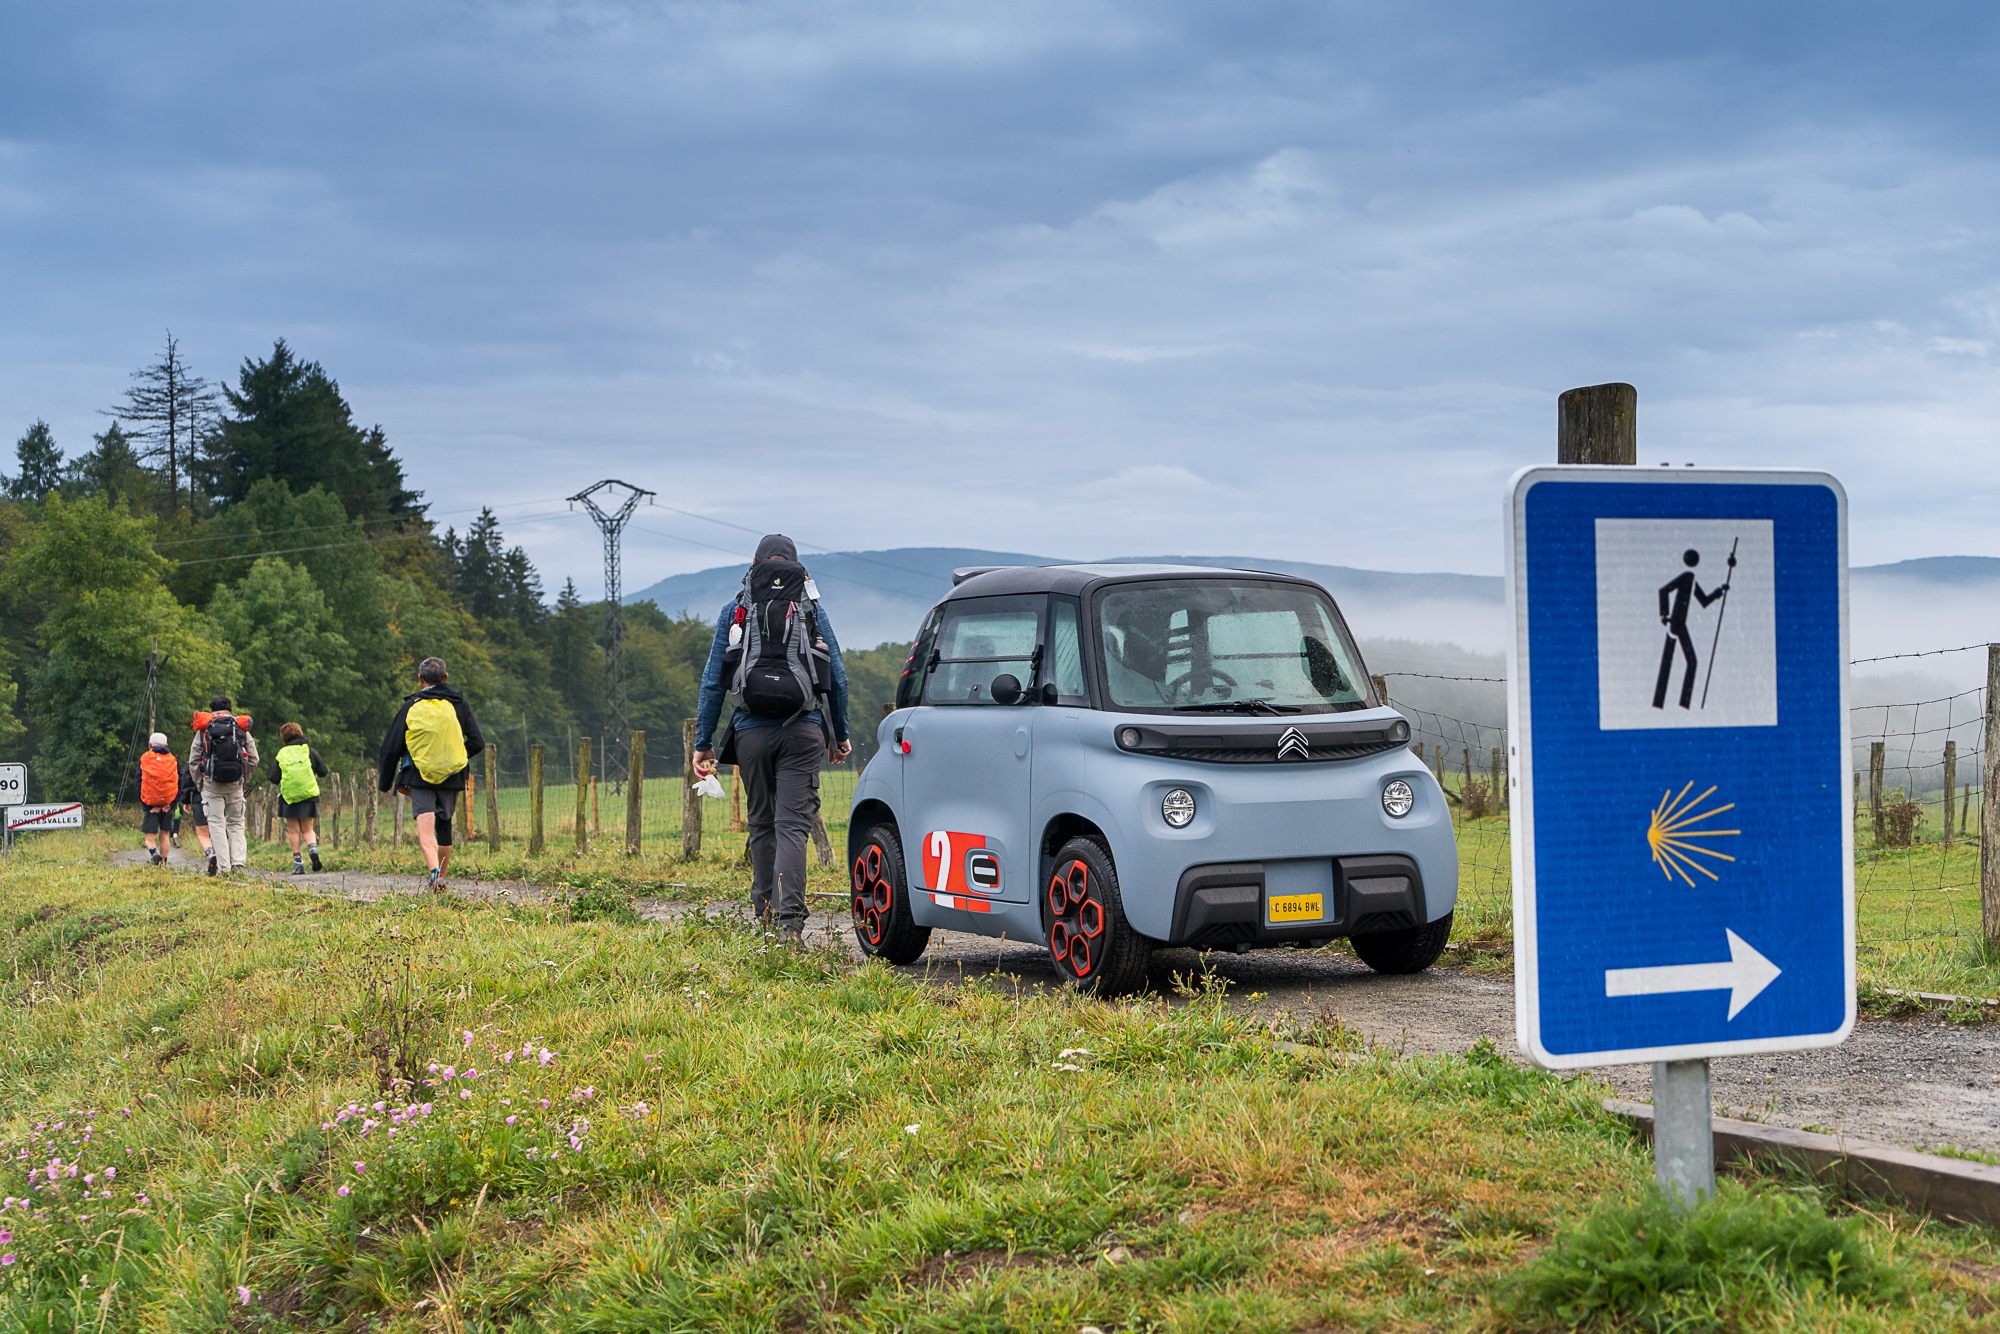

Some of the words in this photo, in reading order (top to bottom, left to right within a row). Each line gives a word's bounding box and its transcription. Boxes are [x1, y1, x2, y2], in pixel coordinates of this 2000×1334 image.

[12, 816, 78, 826] RONCESVALLES
[930, 830, 955, 909] 2
[1275, 902, 1280, 912] C
[1282, 902, 1302, 912] 6894
[1305, 901, 1320, 912] BWL
